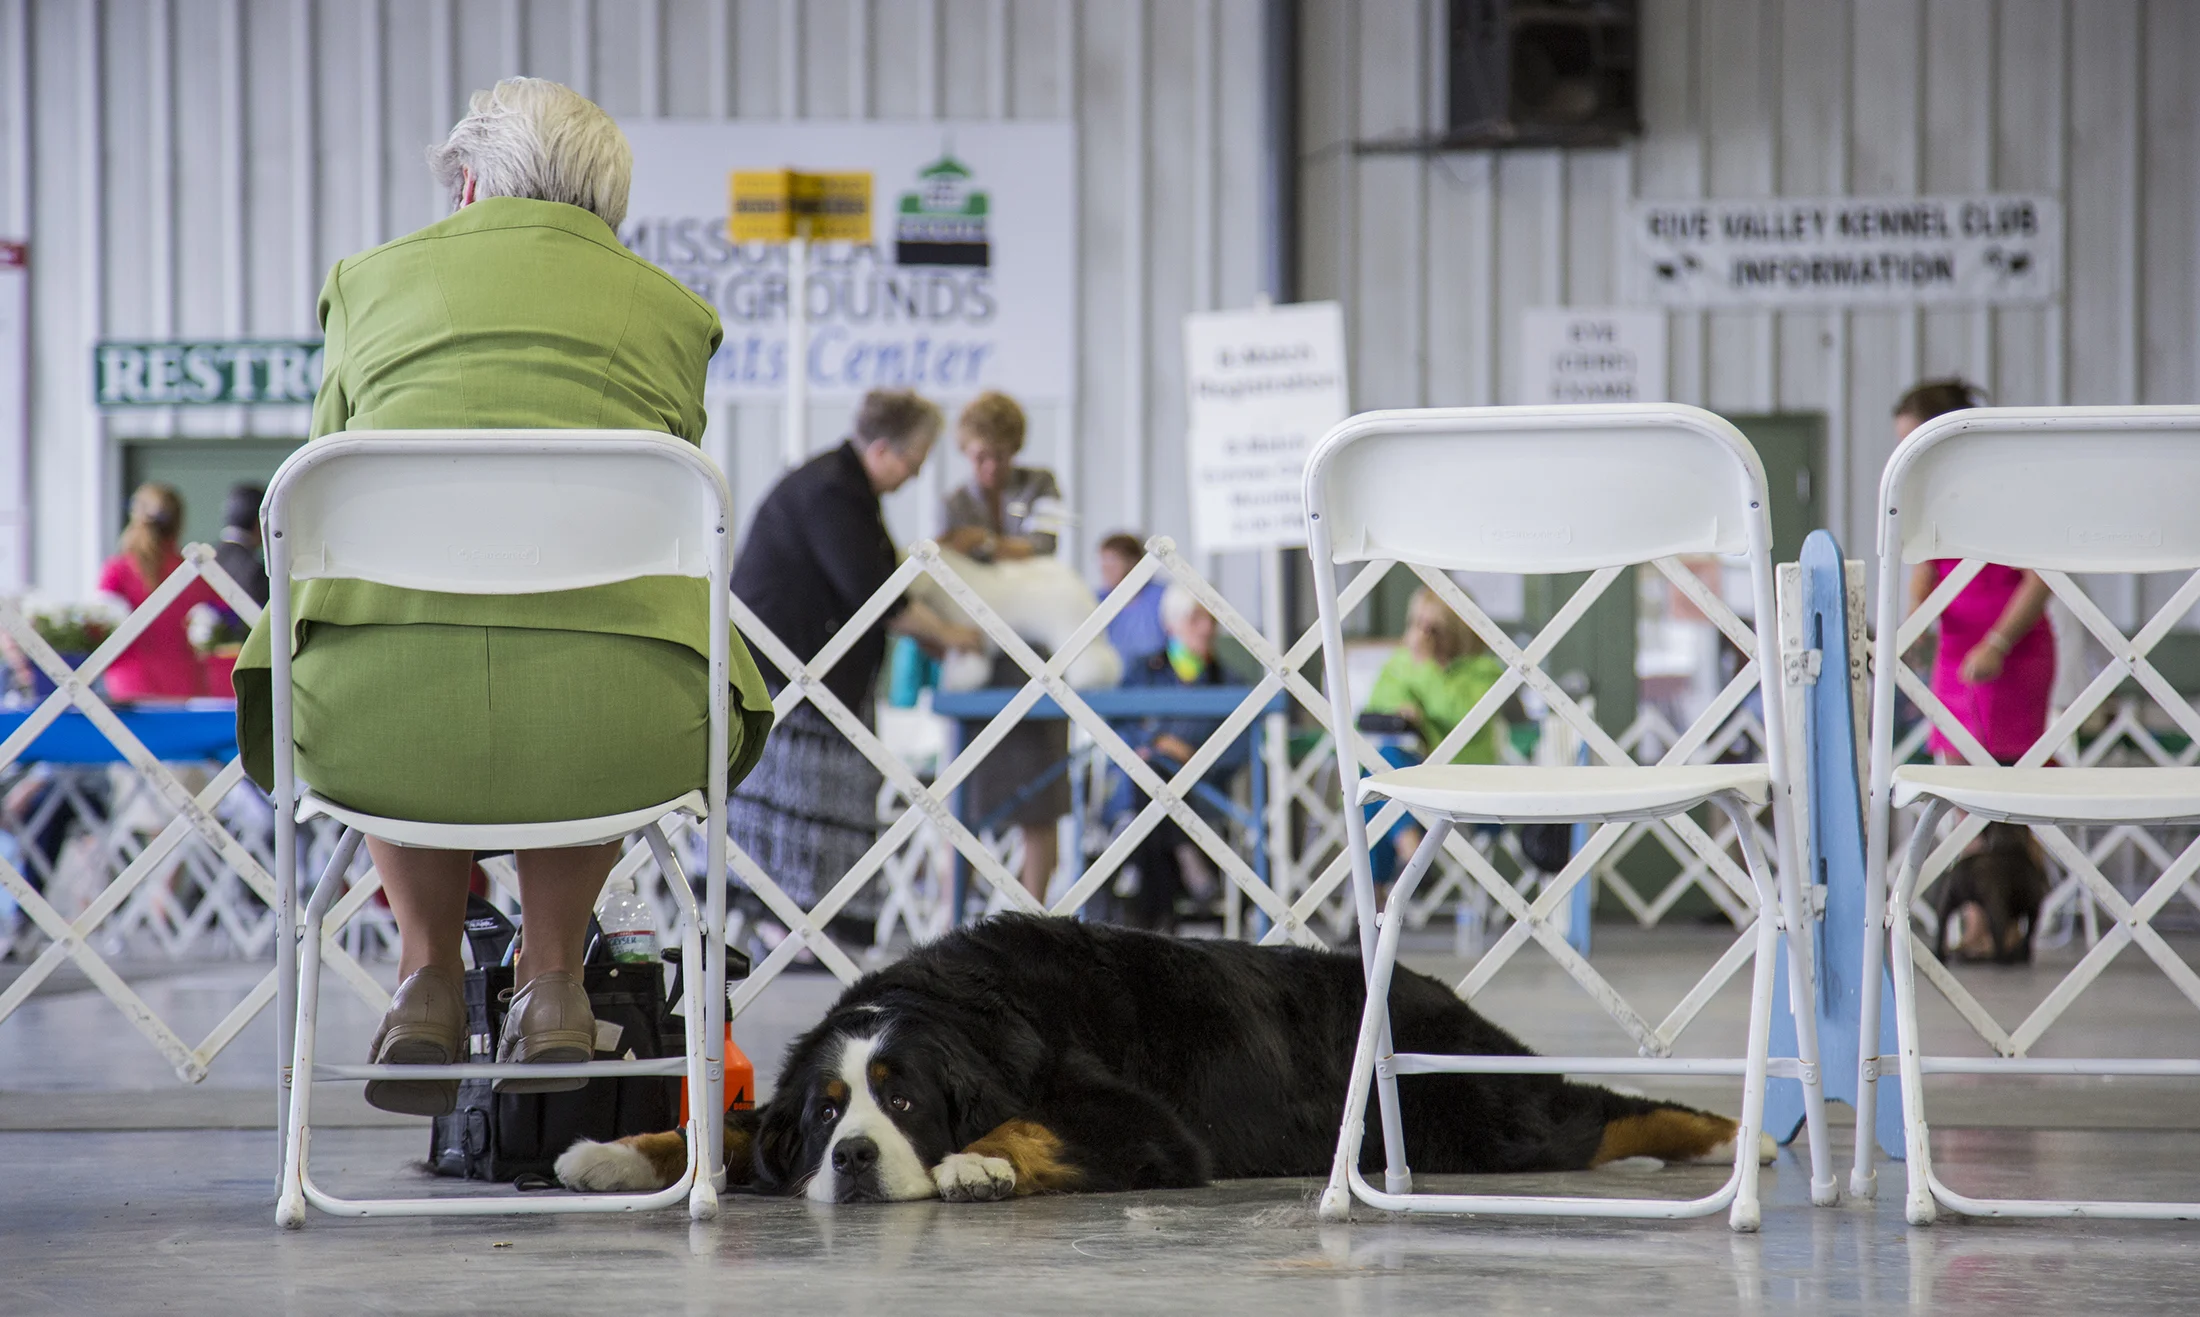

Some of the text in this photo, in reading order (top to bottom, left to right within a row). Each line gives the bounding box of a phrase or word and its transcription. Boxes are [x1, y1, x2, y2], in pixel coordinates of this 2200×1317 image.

[1723, 205, 1829, 241] VALLEY
[1836, 203, 1949, 239] KENNEL
[1959, 202, 2039, 237] CLUB
[1731, 251, 1955, 287] INFORMATION
[704, 330, 993, 388] nts Center
